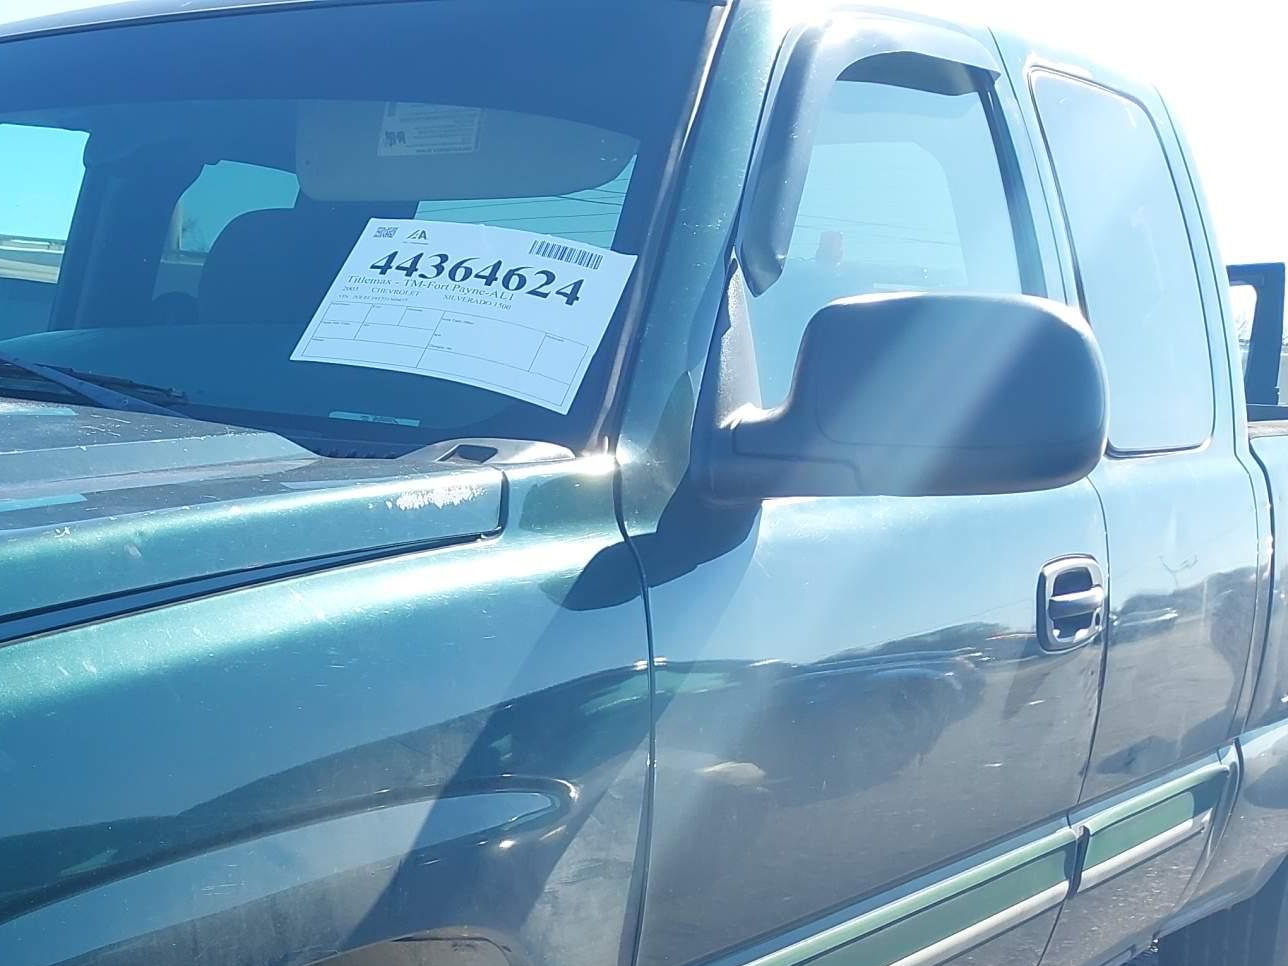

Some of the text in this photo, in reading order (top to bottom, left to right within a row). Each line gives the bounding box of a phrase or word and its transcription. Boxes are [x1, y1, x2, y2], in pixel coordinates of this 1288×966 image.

[348, 275, 391, 286] Titlemax
[404, 279, 449, 291] TM-Fort
[369, 250, 585, 306] 44364624
[372, 287, 422, 297] CHEVROLET
[444, 294, 492, 306] SILVERADO
[494, 301, 512, 311] 1500
